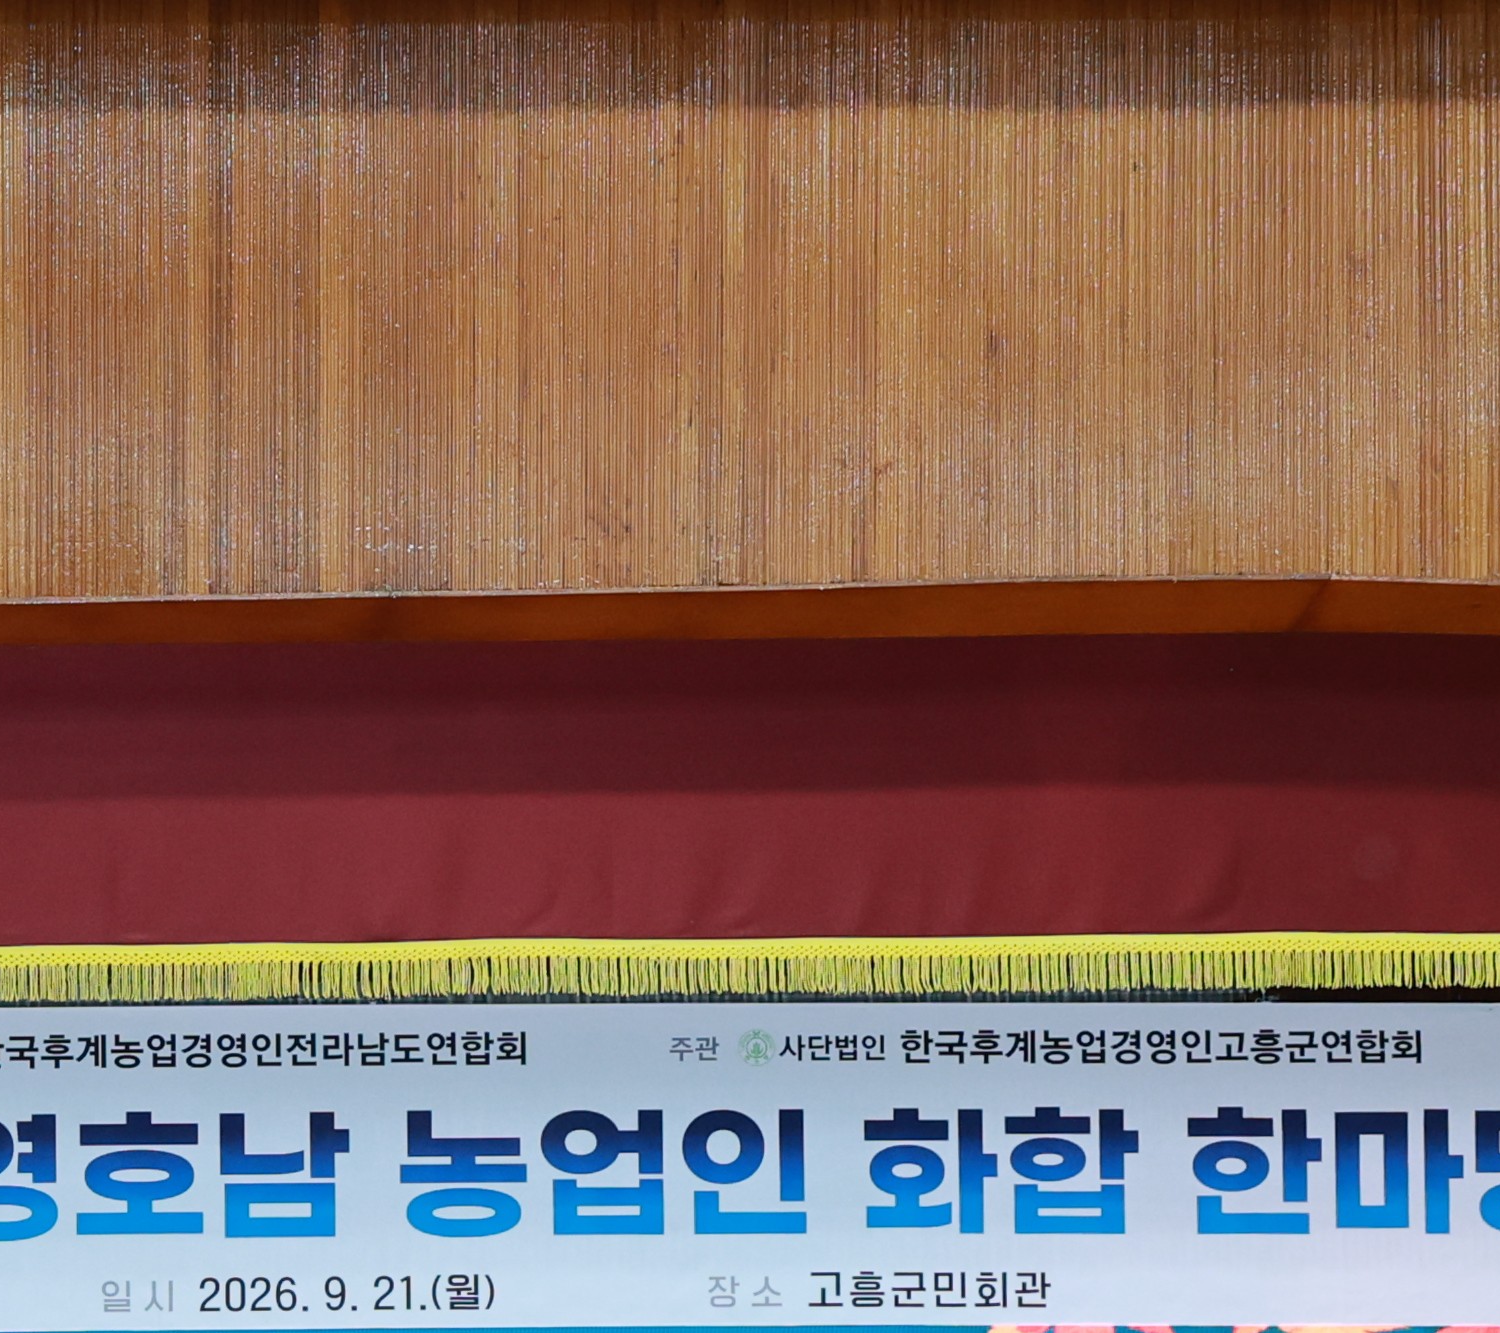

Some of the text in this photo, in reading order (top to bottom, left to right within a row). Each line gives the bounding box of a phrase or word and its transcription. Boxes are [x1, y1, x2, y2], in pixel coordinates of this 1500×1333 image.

[669, 1026, 1425, 1067] 주관 사단법인 한국후계농업경영인고흥군연합회
[398, 1108, 805, 1238] 농업인
[863, 1106, 1139, 1235] 화합
[198, 1274, 310, 1315] 2026.
[322, 1274, 355, 1315] 9.
[374, 1272, 497, 1314] 21.(월)
[807, 1269, 1051, 1310] 고흥군민회관
